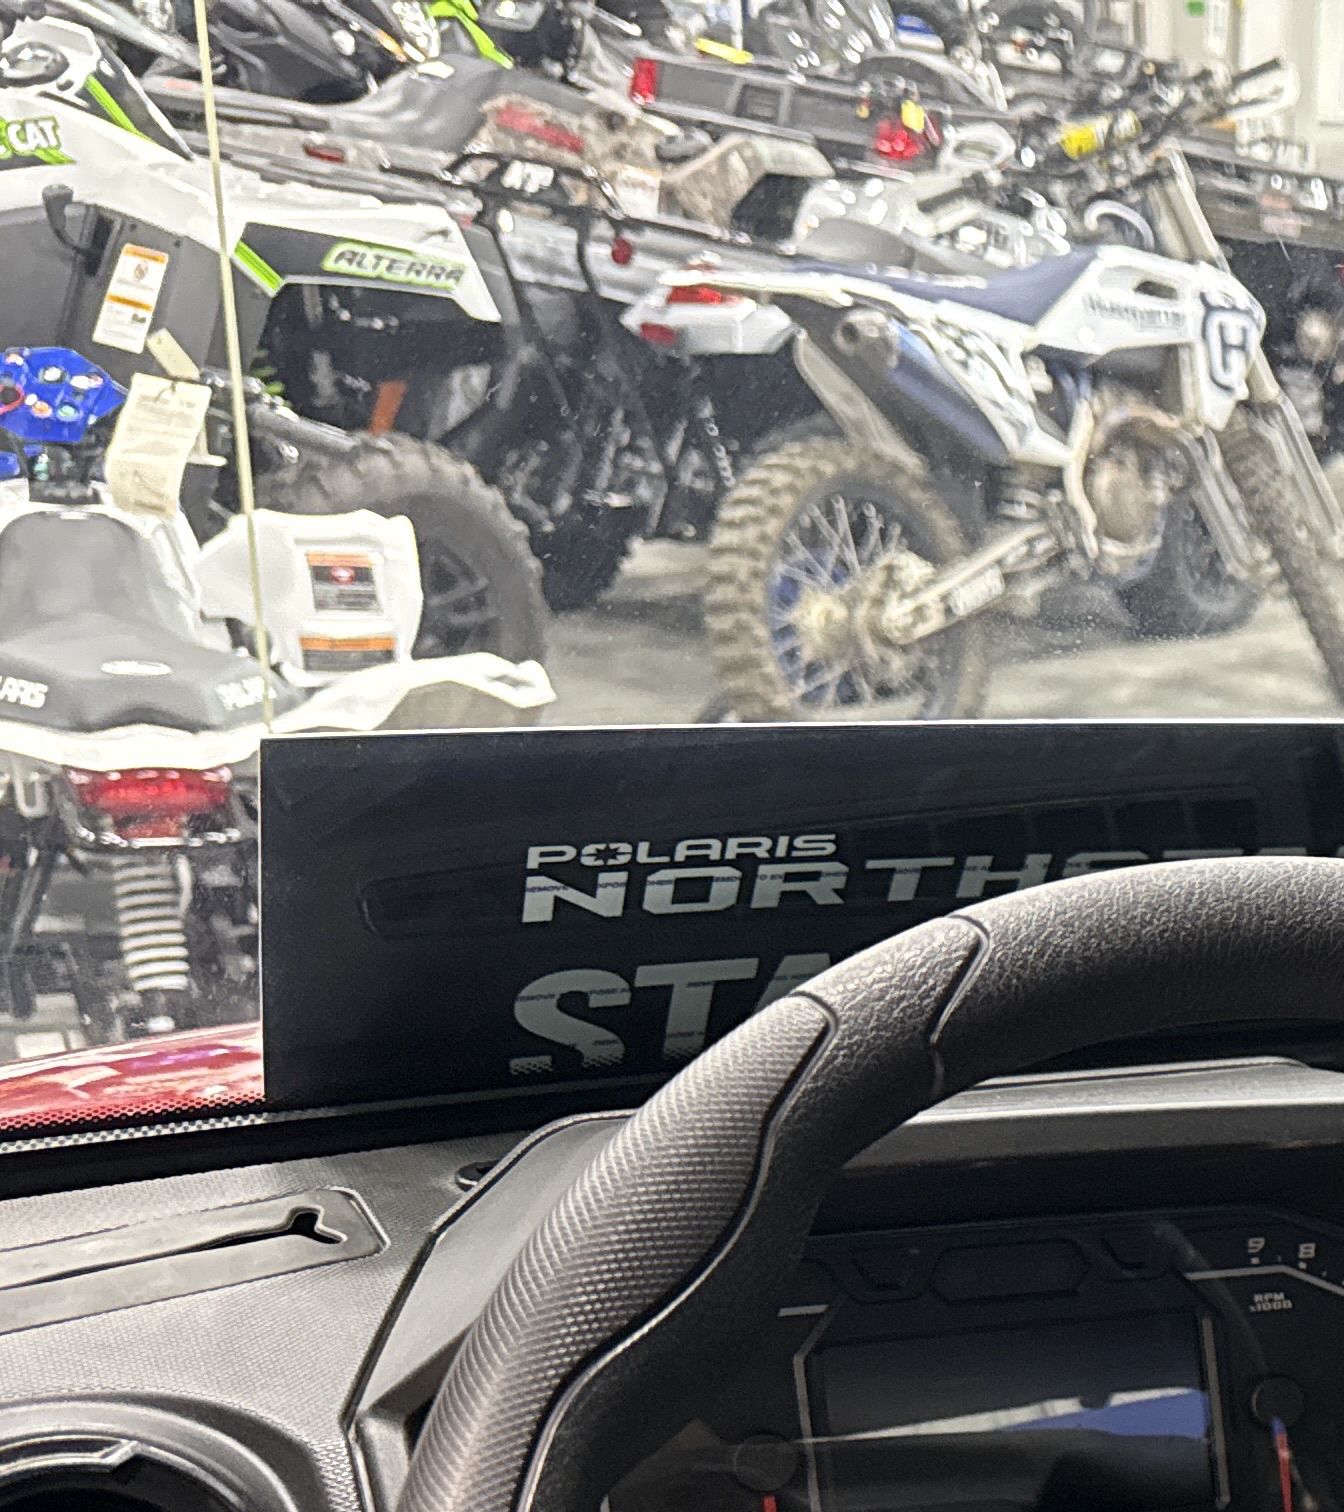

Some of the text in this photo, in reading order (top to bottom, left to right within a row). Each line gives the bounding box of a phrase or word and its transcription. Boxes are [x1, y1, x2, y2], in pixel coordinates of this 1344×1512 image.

[7, 119, 58, 151] CAT
[333, 249, 466, 283] ALTERRA
[0, 675, 49, 709] ARIS
[526, 834, 836, 869] POLARIS
[1248, 1237, 1266, 1253] 9
[1298, 1242, 1316, 1259] 8
[1254, 1292, 1285, 1303] RPM
